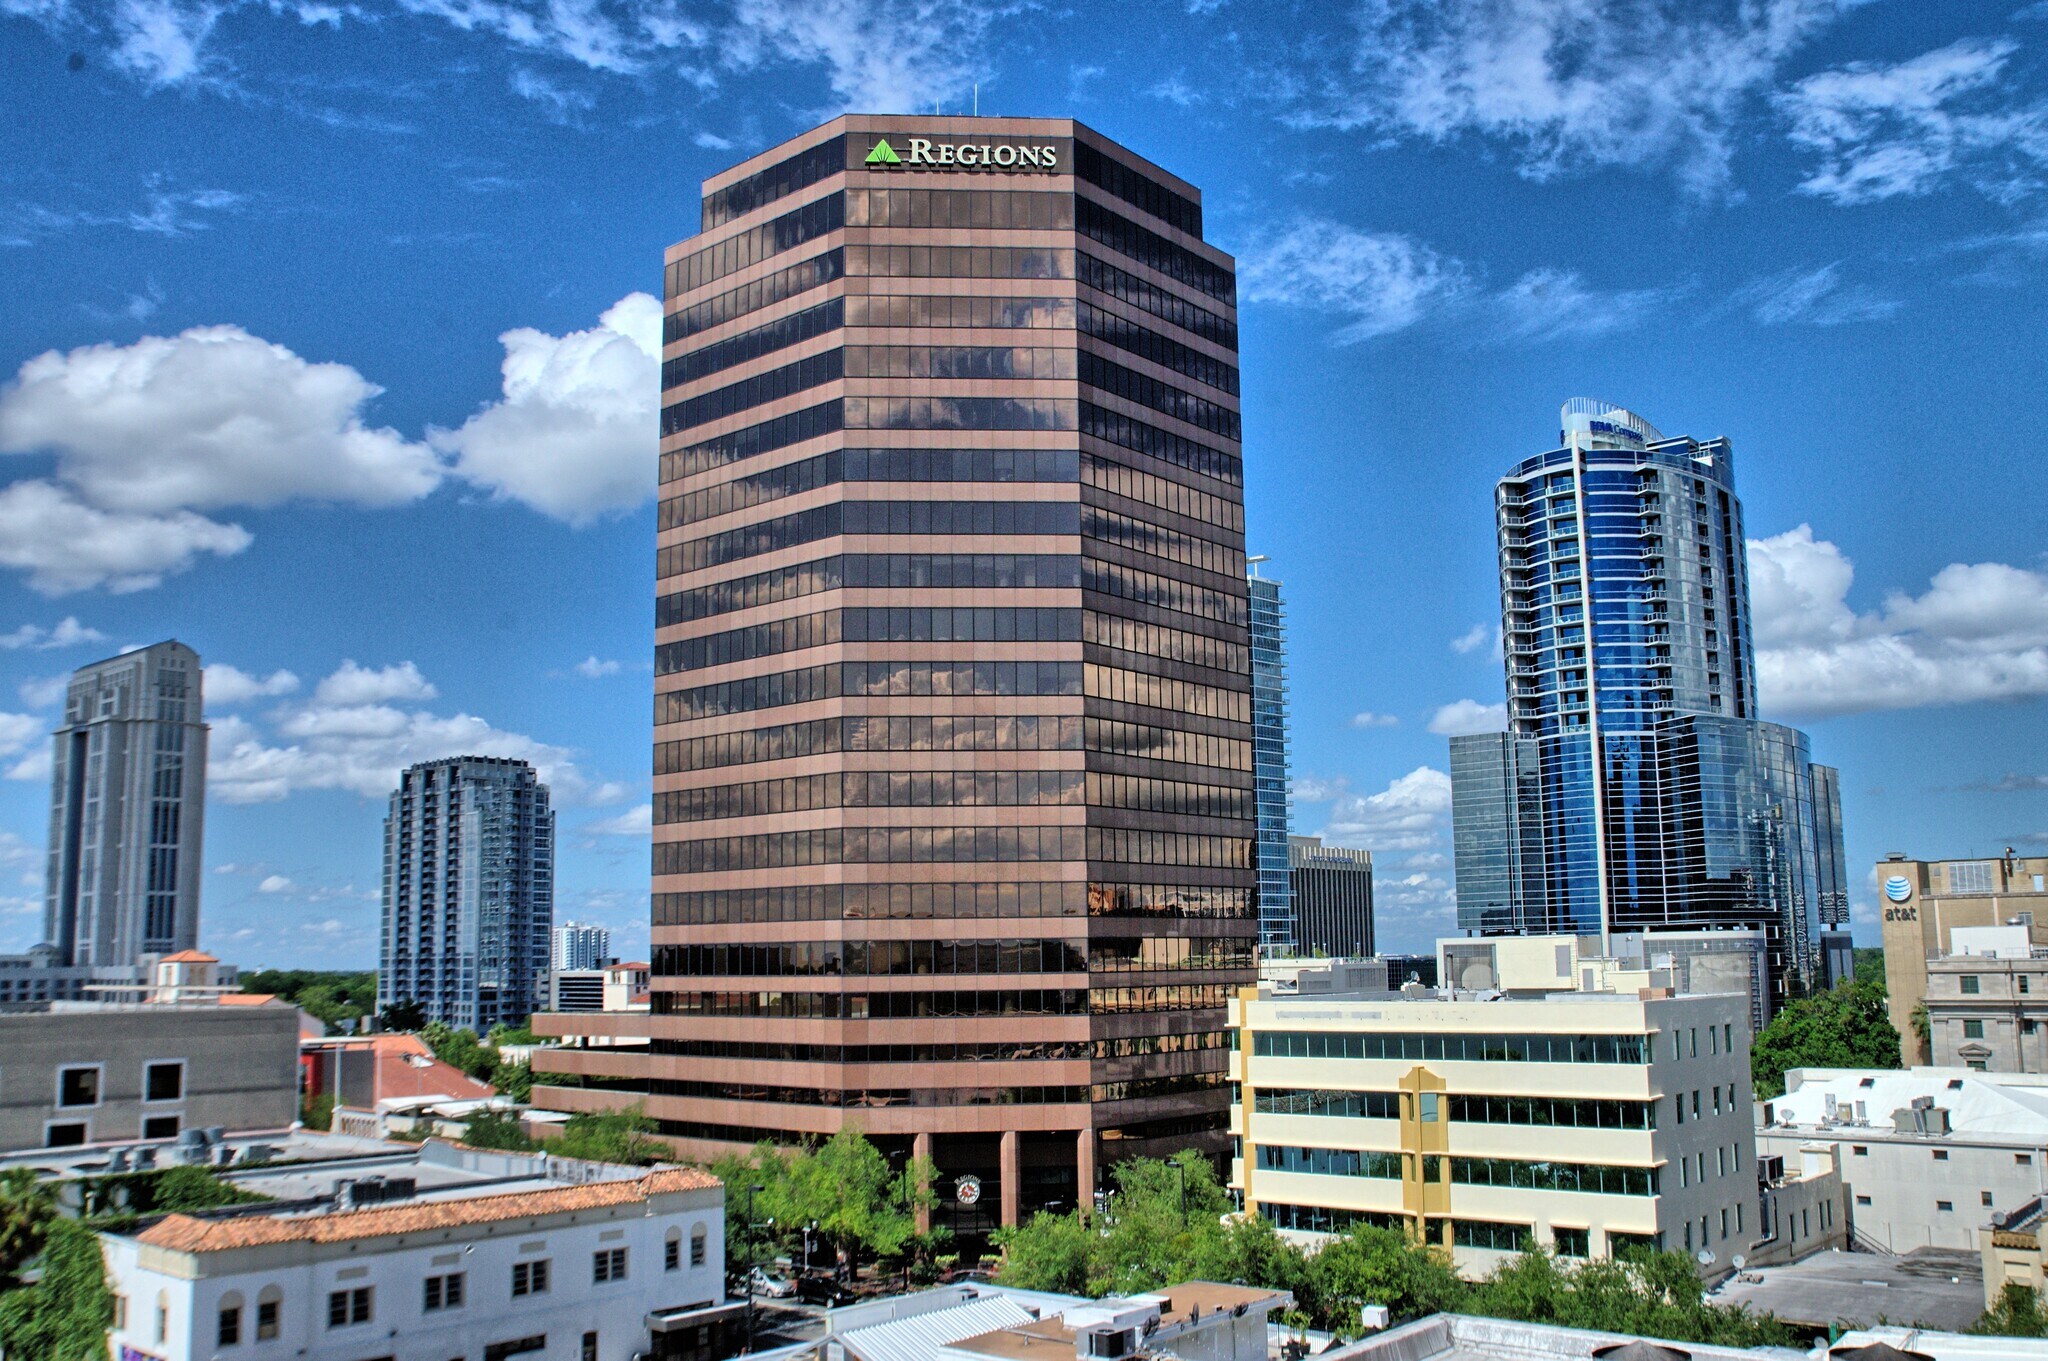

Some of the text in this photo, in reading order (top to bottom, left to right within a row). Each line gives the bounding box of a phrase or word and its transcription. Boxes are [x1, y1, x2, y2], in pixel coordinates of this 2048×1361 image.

[909, 139, 1057, 166] REGIONS
[1614, 425, 1643, 441] Compass
[1885, 906, 1917, 921] at&t
